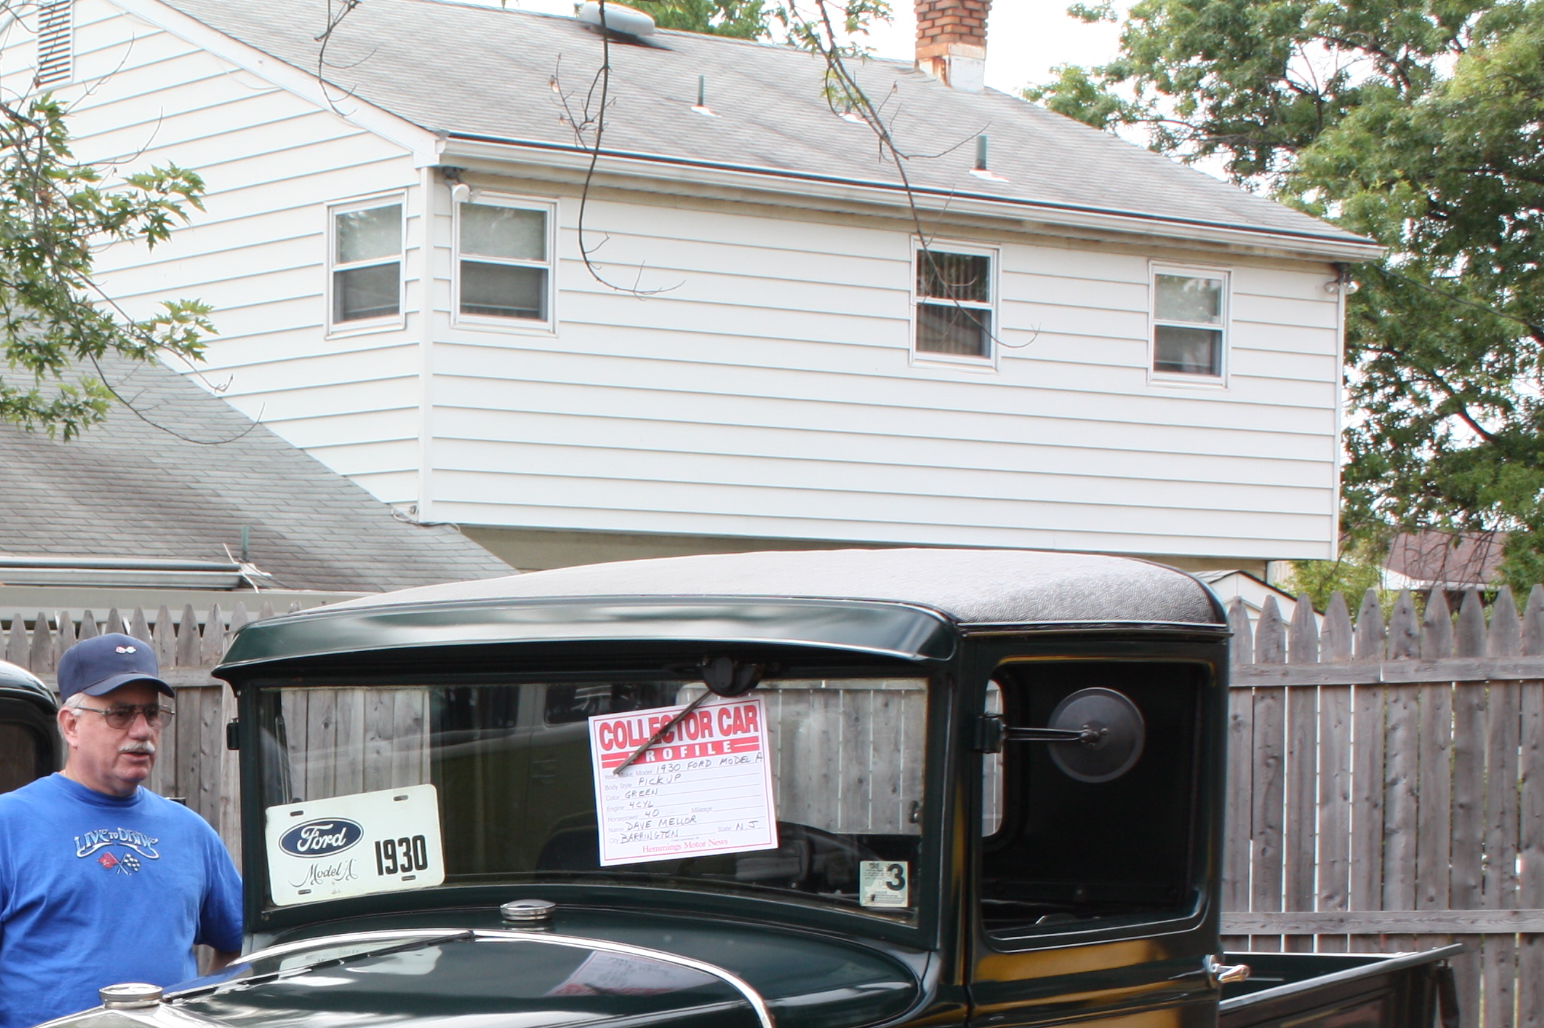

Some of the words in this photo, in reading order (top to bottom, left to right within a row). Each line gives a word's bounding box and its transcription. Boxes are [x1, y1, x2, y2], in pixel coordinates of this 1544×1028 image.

[599, 711, 714, 751] COLLECTOR
[717, 705, 759, 736] CAR
[656, 763, 681, 775] 1930
[687, 759, 712, 771] FORD
[719, 755, 751, 766] MODEL
[755, 751, 763, 763] A
[625, 788, 659, 799] GREEN
[625, 820, 652, 831] DAVE
[658, 815, 698, 828] MELLOR
[644, 808, 660, 818] 40
[74, 828, 109, 853] LIVE
[108, 831, 119, 840] TO
[117, 827, 159, 851] DRIVE
[297, 823, 347, 852] Ford
[620, 829, 679, 845] BARRINGTON
[642, 844, 682, 853] Hemmings
[684, 841, 706, 849] Motor
[708, 838, 729, 847] News
[374, 834, 429, 877] 1930
[288, 861, 342, 887] Model
[886, 863, 906, 891] 3
